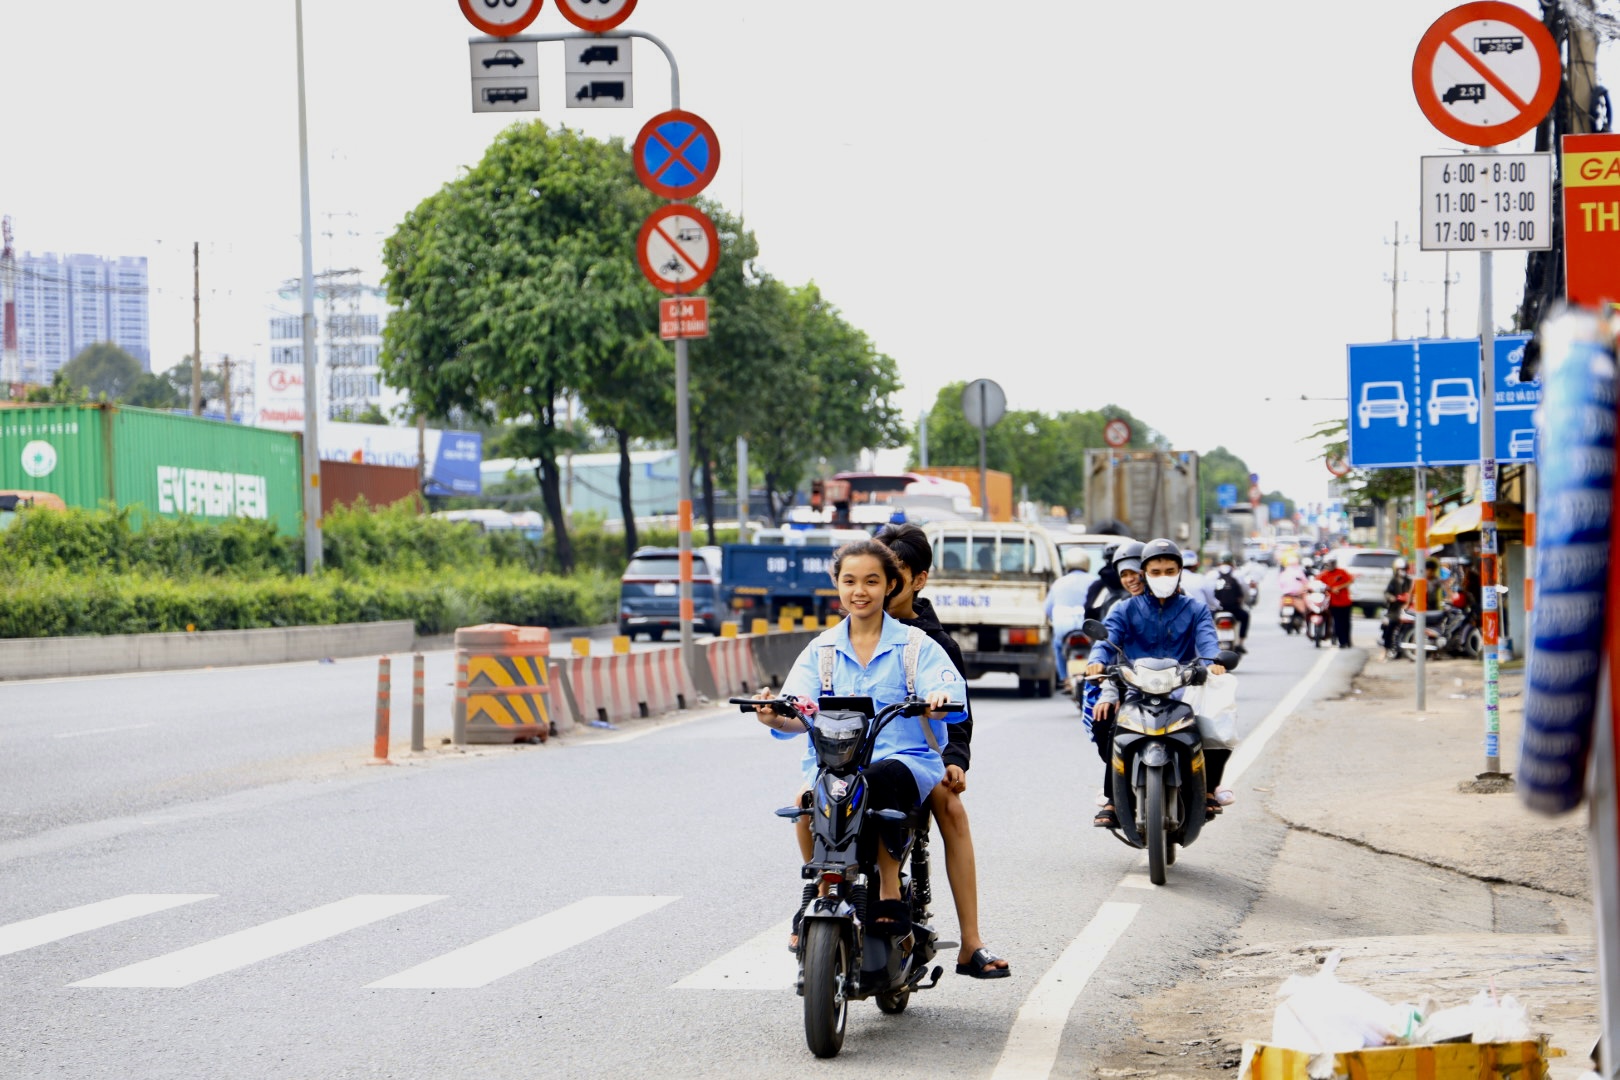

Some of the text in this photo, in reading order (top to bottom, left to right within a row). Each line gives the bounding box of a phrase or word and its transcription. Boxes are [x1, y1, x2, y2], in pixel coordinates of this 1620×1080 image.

[1443, 162, 1475, 183] 6:00
[1493, 162, 1526, 183] 8:00
[1435, 192, 1475, 213] 11:00
[1494, 191, 1535, 212] 13:00
[1435, 221, 1475, 242] 17:00
[1494, 220, 1535, 242] 19:00
[157, 465, 268, 519] EVERGREEN
